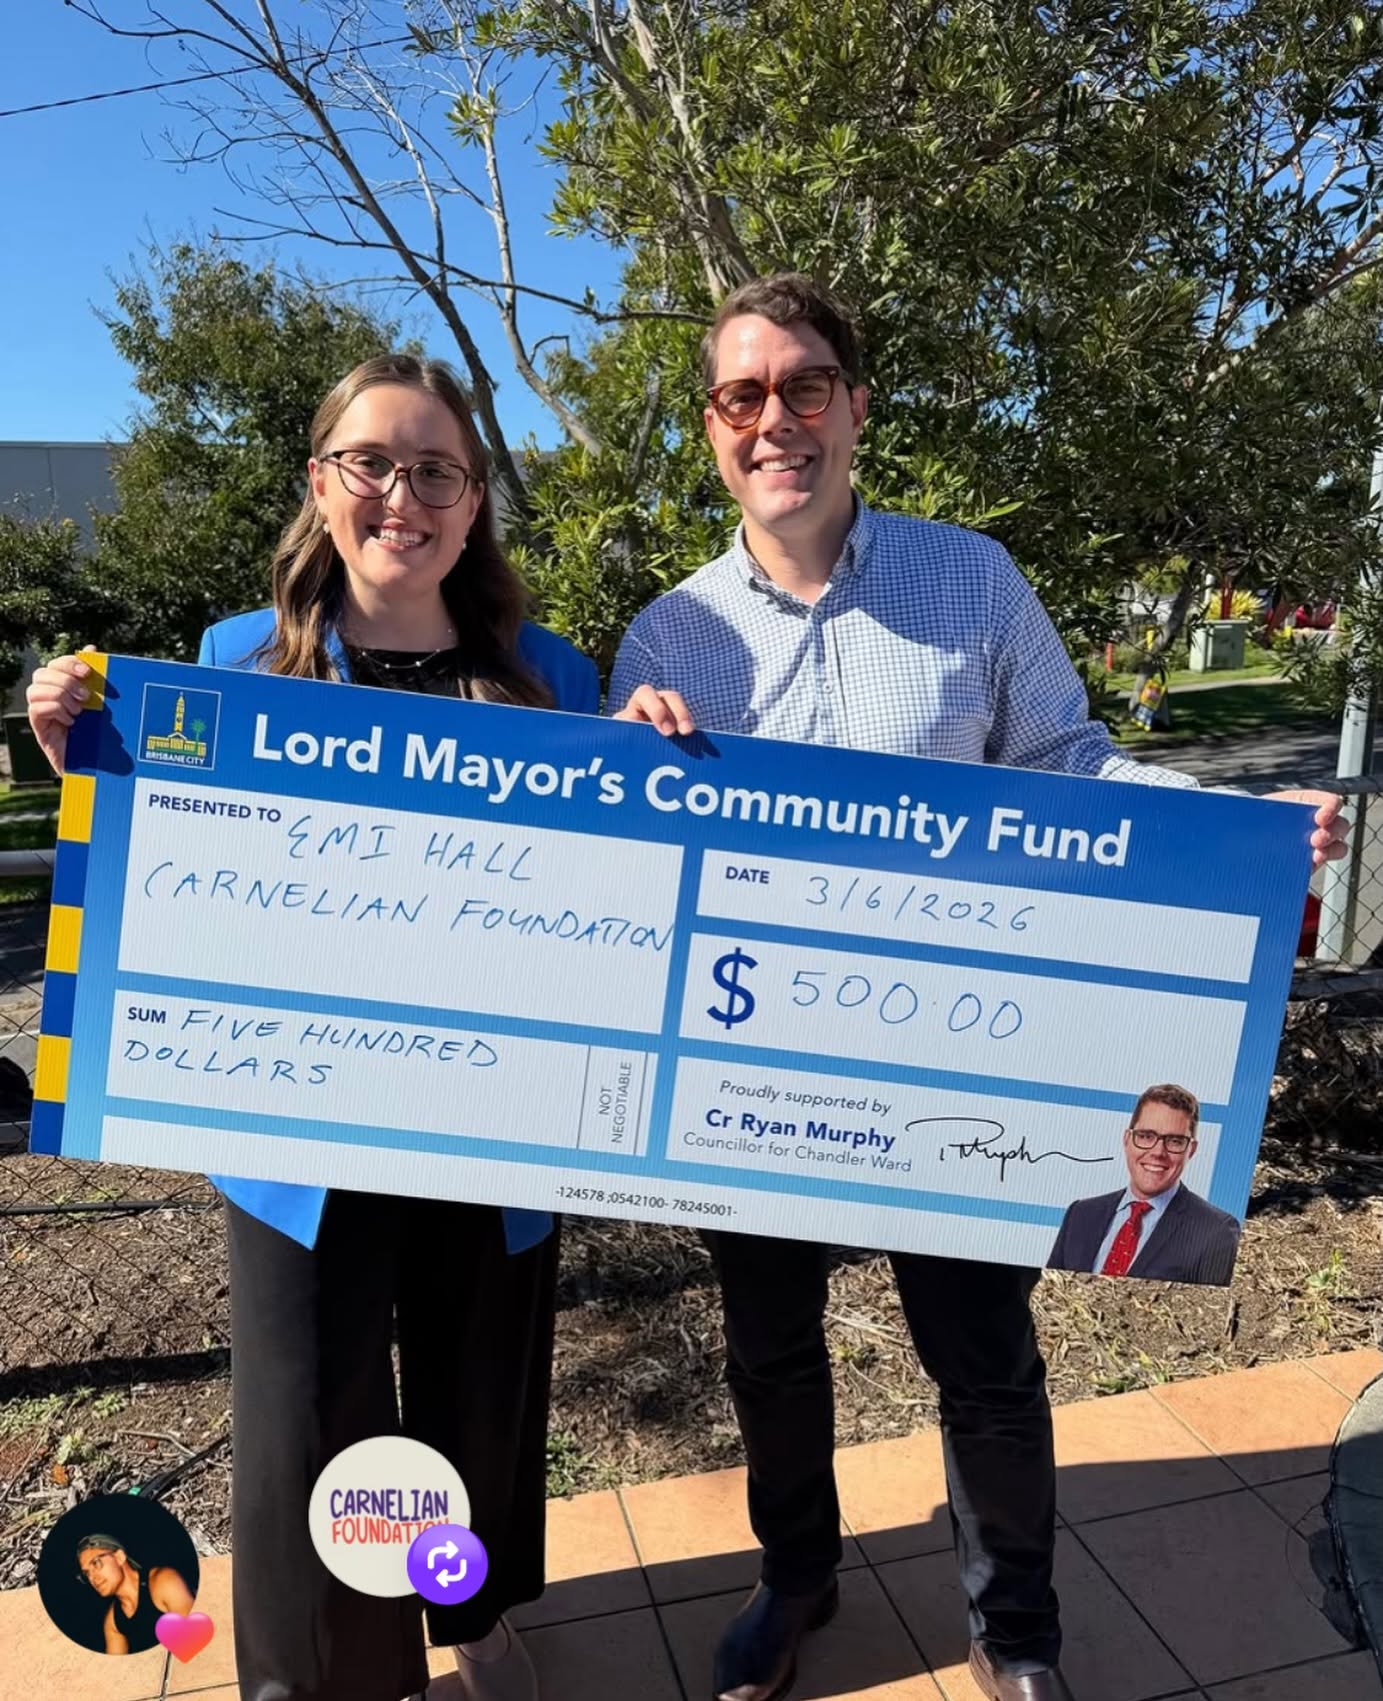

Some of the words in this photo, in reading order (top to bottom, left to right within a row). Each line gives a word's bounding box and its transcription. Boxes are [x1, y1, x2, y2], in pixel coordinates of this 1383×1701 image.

[148, 794, 252, 821] PRESENTED
[255, 806, 282, 823] TO
[252, 713, 383, 773] Lord
[403, 734, 626, 806] Mayor's
[644, 765, 969, 858] Community
[987, 807, 1132, 867] Fund
[286, 815, 396, 860] EMI
[425, 832, 533, 881] HALL
[724, 865, 770, 884] DATE
[144, 861, 429, 924] CARNELIAN
[450, 898, 674, 953] FOUNDATION
[805, 875, 1036, 932] 3/6/2026
[706, 947, 759, 1030] $
[127, 1006, 166, 1024] SUM
[180, 1009, 283, 1041] FIVE
[300, 1022, 498, 1067] HUNDRED
[123, 1039, 332, 1085] DOLLARS
[599, 1086, 612, 1117] NOT
[611, 1061, 633, 1144] NEGOTIABLE
[719, 1080, 780, 1103] Proudly
[784, 1089, 868, 1111] supported
[871, 1099, 892, 1117] by
[683, 1131, 762, 1154] Councillor
[768, 1141, 790, 1157] for
[795, 1145, 866, 1166] Chandler
[871, 1155, 912, 1172] Ward
[706, 1109, 733, 1128] Cr
[740, 1113, 797, 1137] Ryan
[806, 1121, 896, 1153] Murphy
